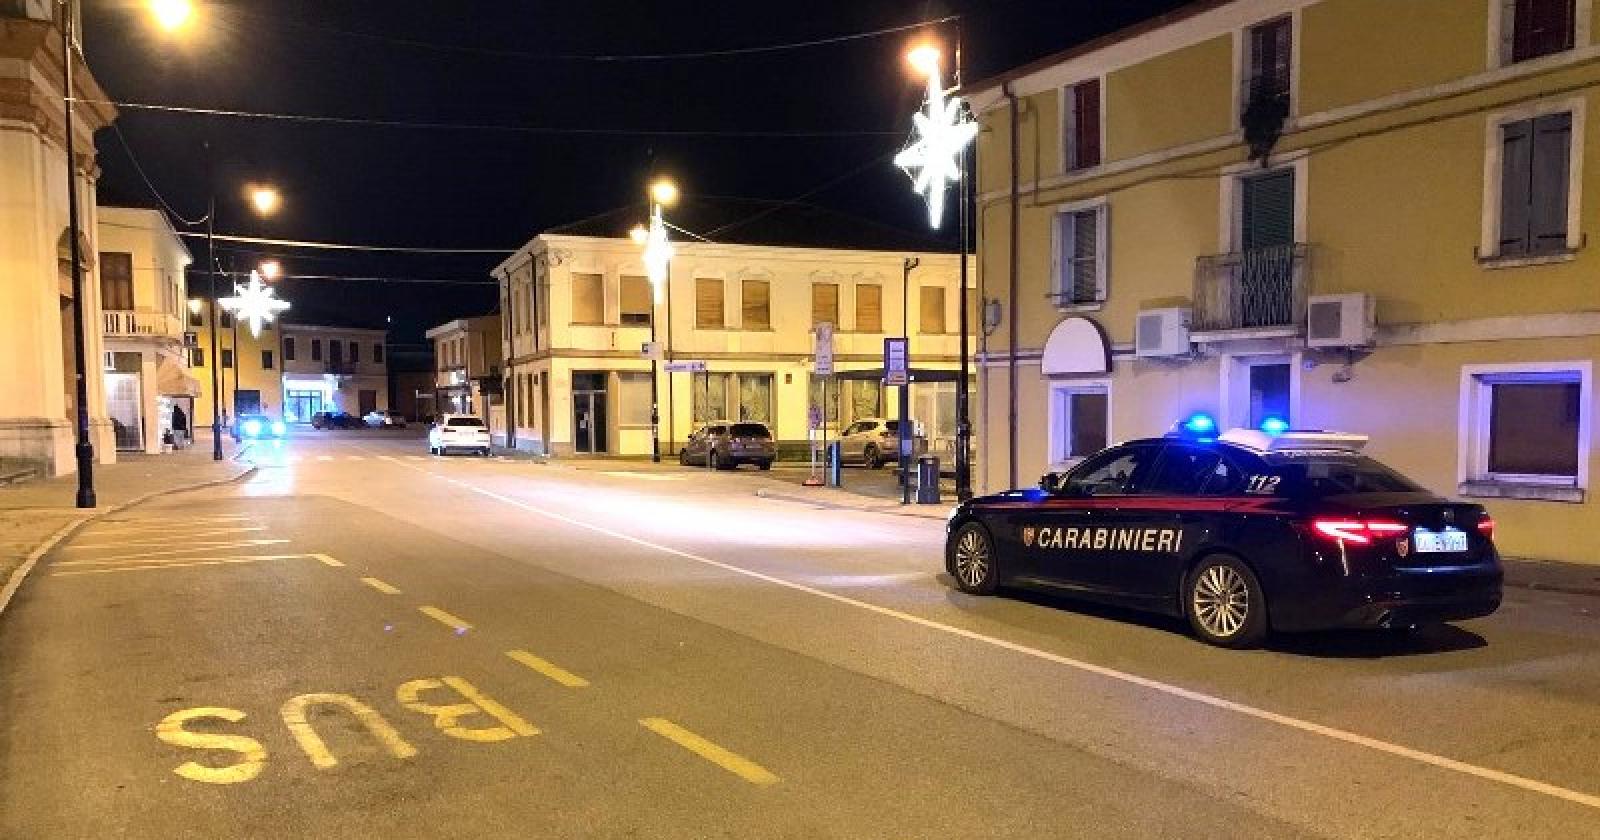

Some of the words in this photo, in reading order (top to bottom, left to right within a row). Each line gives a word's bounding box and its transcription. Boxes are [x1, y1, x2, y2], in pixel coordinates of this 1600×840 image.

[1246, 475, 1281, 494] 112
[1037, 527, 1184, 553] CARABINIERI
[155, 676, 541, 784] BUS
